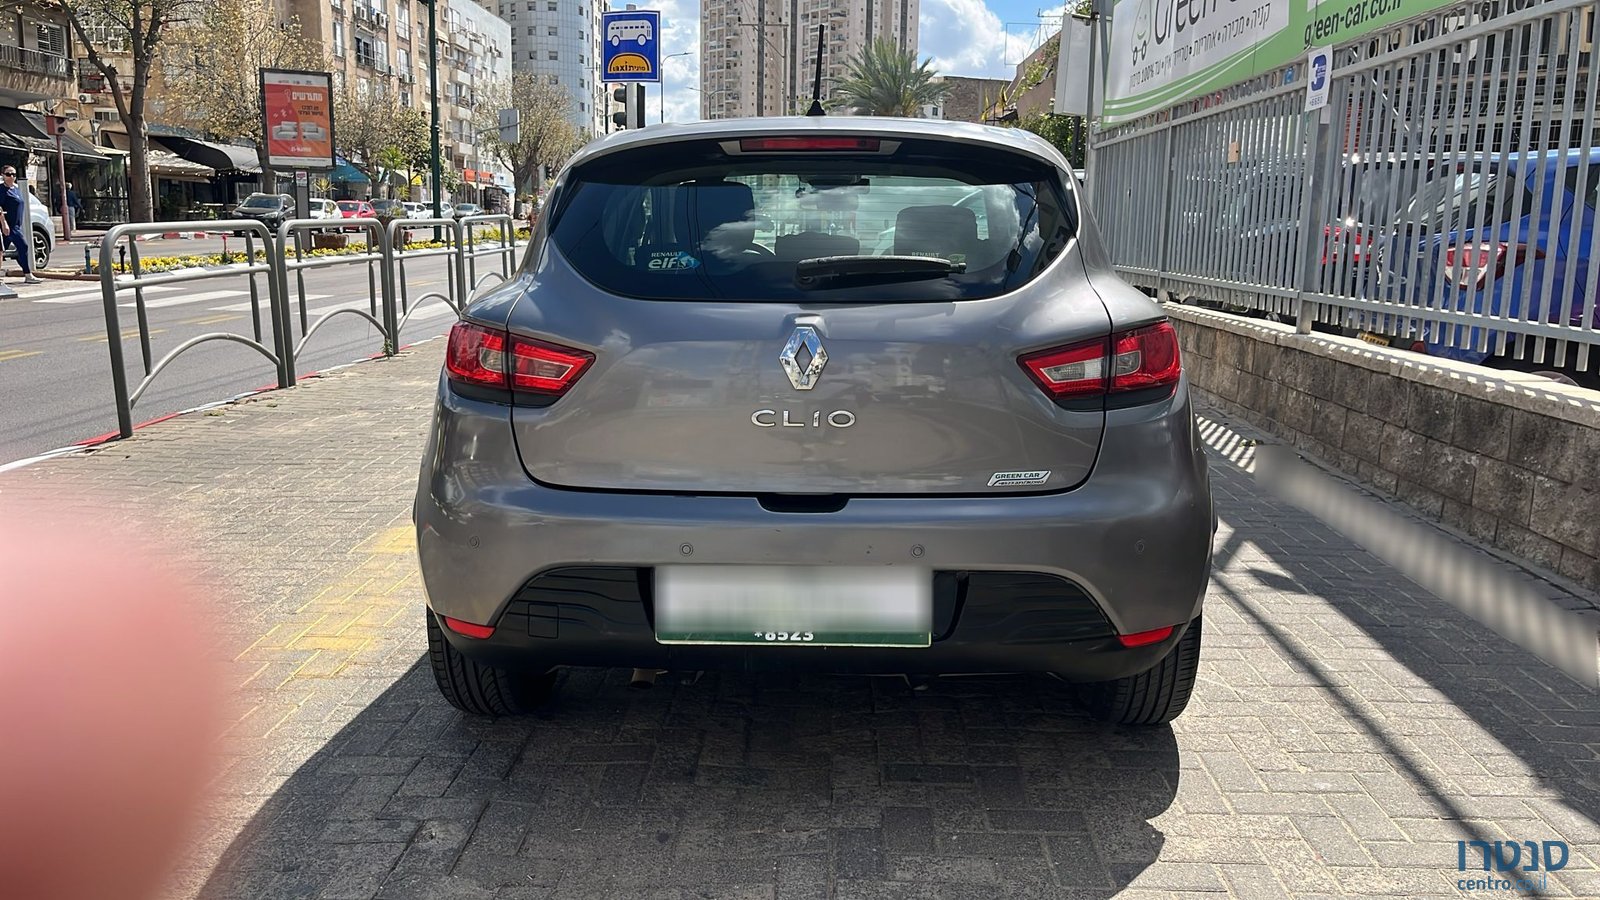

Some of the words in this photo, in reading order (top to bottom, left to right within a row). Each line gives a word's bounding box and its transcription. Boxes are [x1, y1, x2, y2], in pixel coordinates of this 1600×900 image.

[613, 61, 628, 71] taxi
[648, 257, 678, 268] elf
[751, 409, 856, 428] CLIO
